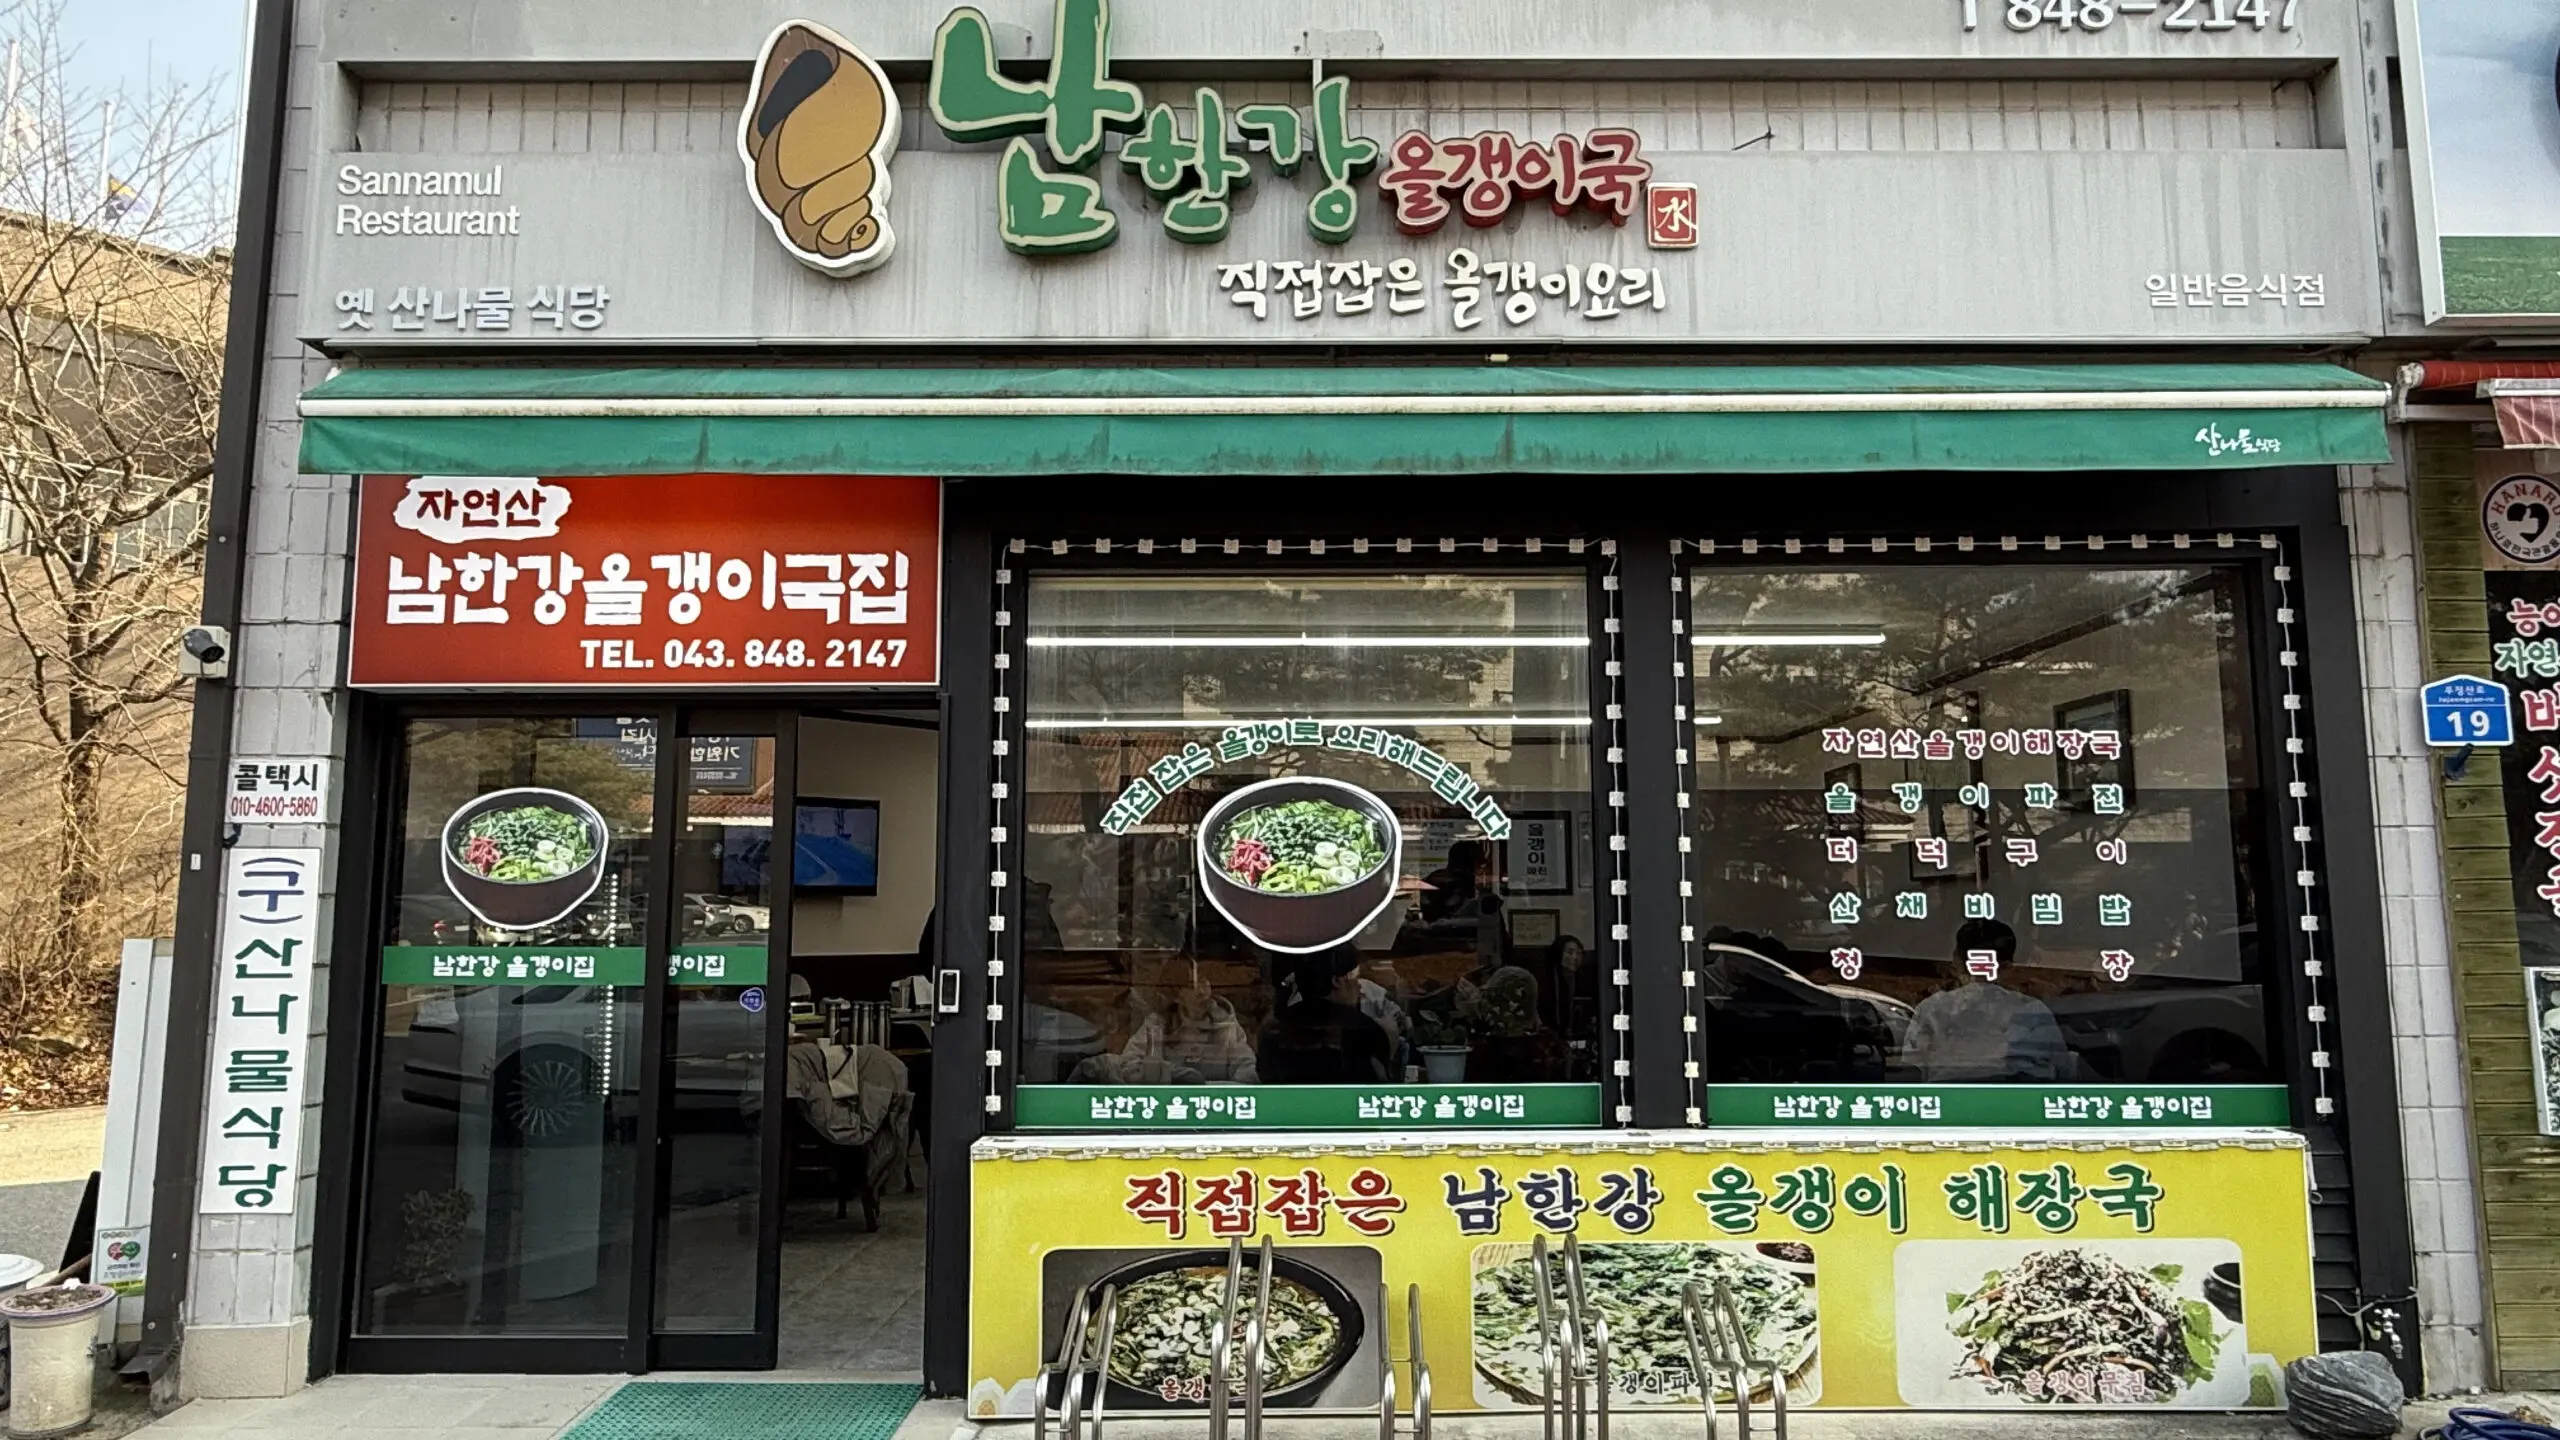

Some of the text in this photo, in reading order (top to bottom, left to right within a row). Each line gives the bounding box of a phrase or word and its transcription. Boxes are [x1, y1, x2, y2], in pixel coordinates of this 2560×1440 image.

[929, 0, 1380, 256] 남한강
[337, 164, 503, 196] Sannamul
[1380, 128, 1653, 234] 올갱이국
[336, 204, 521, 236] Restaurant
[1657, 196, 1697, 233] 水
[1217, 256, 1426, 321] 직접잡은
[2144, 272, 2327, 308] 일반음식점
[335, 284, 612, 331] 옛 산나물 식당
[416, 487, 547, 528] 자연산
[386, 549, 909, 626] 남한강올갱이국집
[580, 637, 908, 669] TEL. 043. 848. 2147
[2494, 638, 2560, 678] 자연
[2446, 709, 2490, 738] 19
[1821, 727, 2121, 761] 자연산올갱이해장국
[234, 762, 319, 793] 콜택시
[1099, 777, 1163, 836] 직접
[1147, 741, 1215, 795] 잡은
[1215, 719, 1323, 764] 올갱이로
[1327, 723, 1513, 841] 요리해드립니다
[230, 795, 318, 818] 010-4600-5860
[432, 952, 596, 978] 남한강 올갱이집
[1090, 1095, 1257, 1120] 남한강 올갱이집
[1357, 1094, 1525, 1119] 남한강 올갱이집
[1772, 1095, 1941, 1120] 남한강 올갱이집
[2043, 1094, 2213, 1119] 남한강 올갱이집
[1125, 1160, 2164, 1238] 직접잡은 남한강 올갱이 해장국
